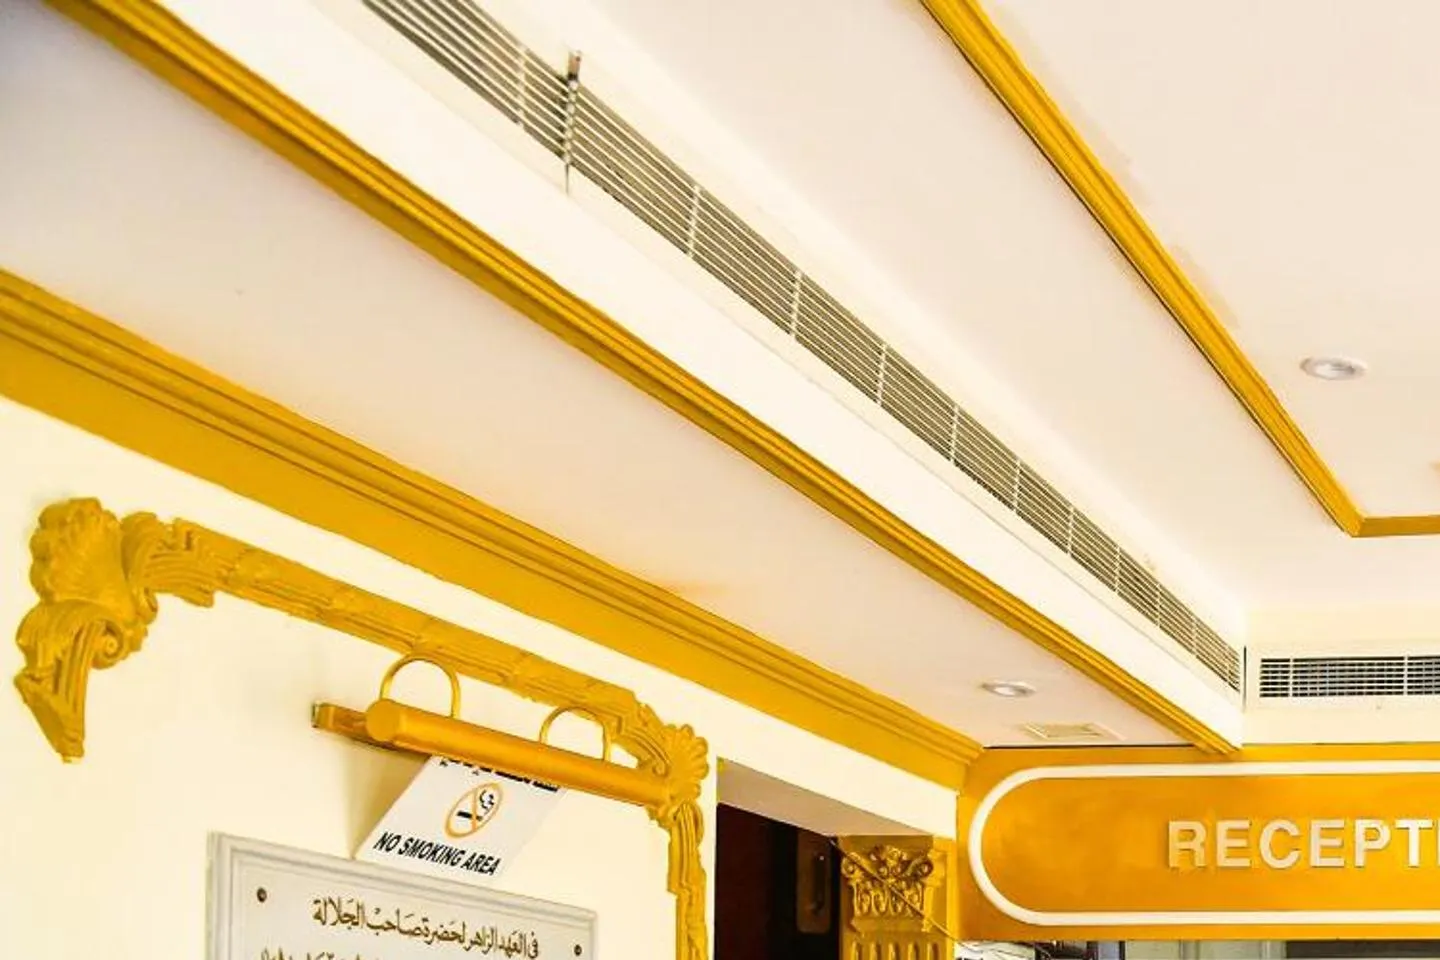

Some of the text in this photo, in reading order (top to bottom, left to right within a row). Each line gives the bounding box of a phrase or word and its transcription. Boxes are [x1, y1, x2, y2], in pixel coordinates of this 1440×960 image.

[373, 831, 501, 876] NO SMOKING AREA
